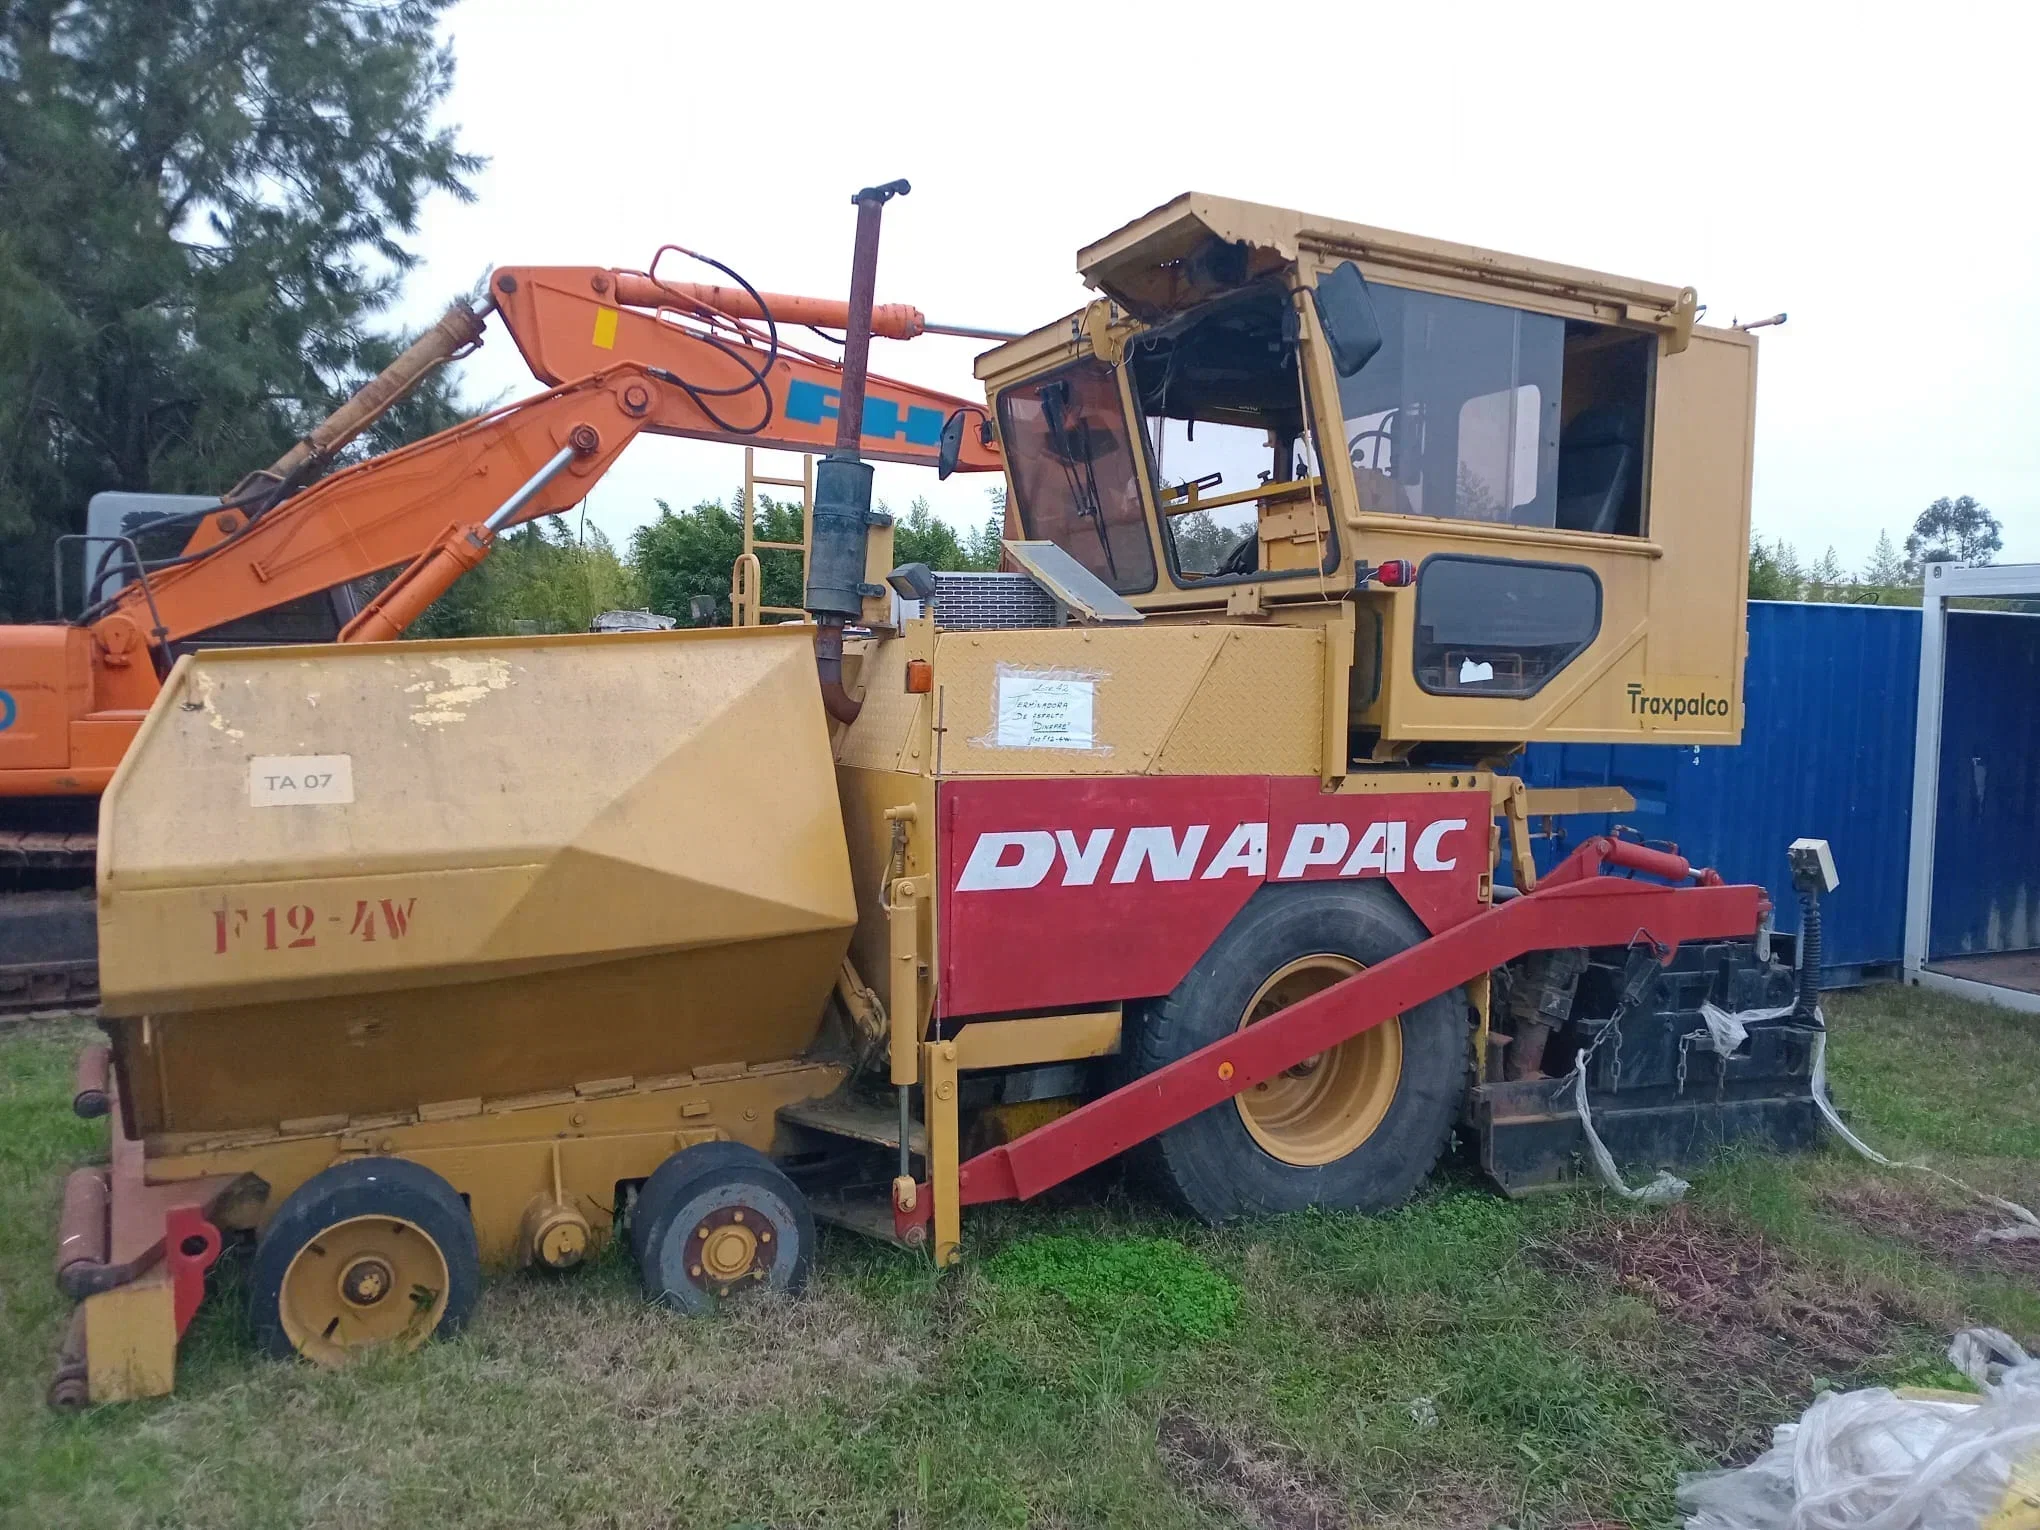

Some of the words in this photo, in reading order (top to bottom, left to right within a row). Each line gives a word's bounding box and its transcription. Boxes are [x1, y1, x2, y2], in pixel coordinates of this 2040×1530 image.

[1627, 684, 1729, 722] Traxpalco
[264, 775, 297, 791] TA
[304, 774, 333, 789] 07
[955, 819, 1467, 892] DYNAPAC
